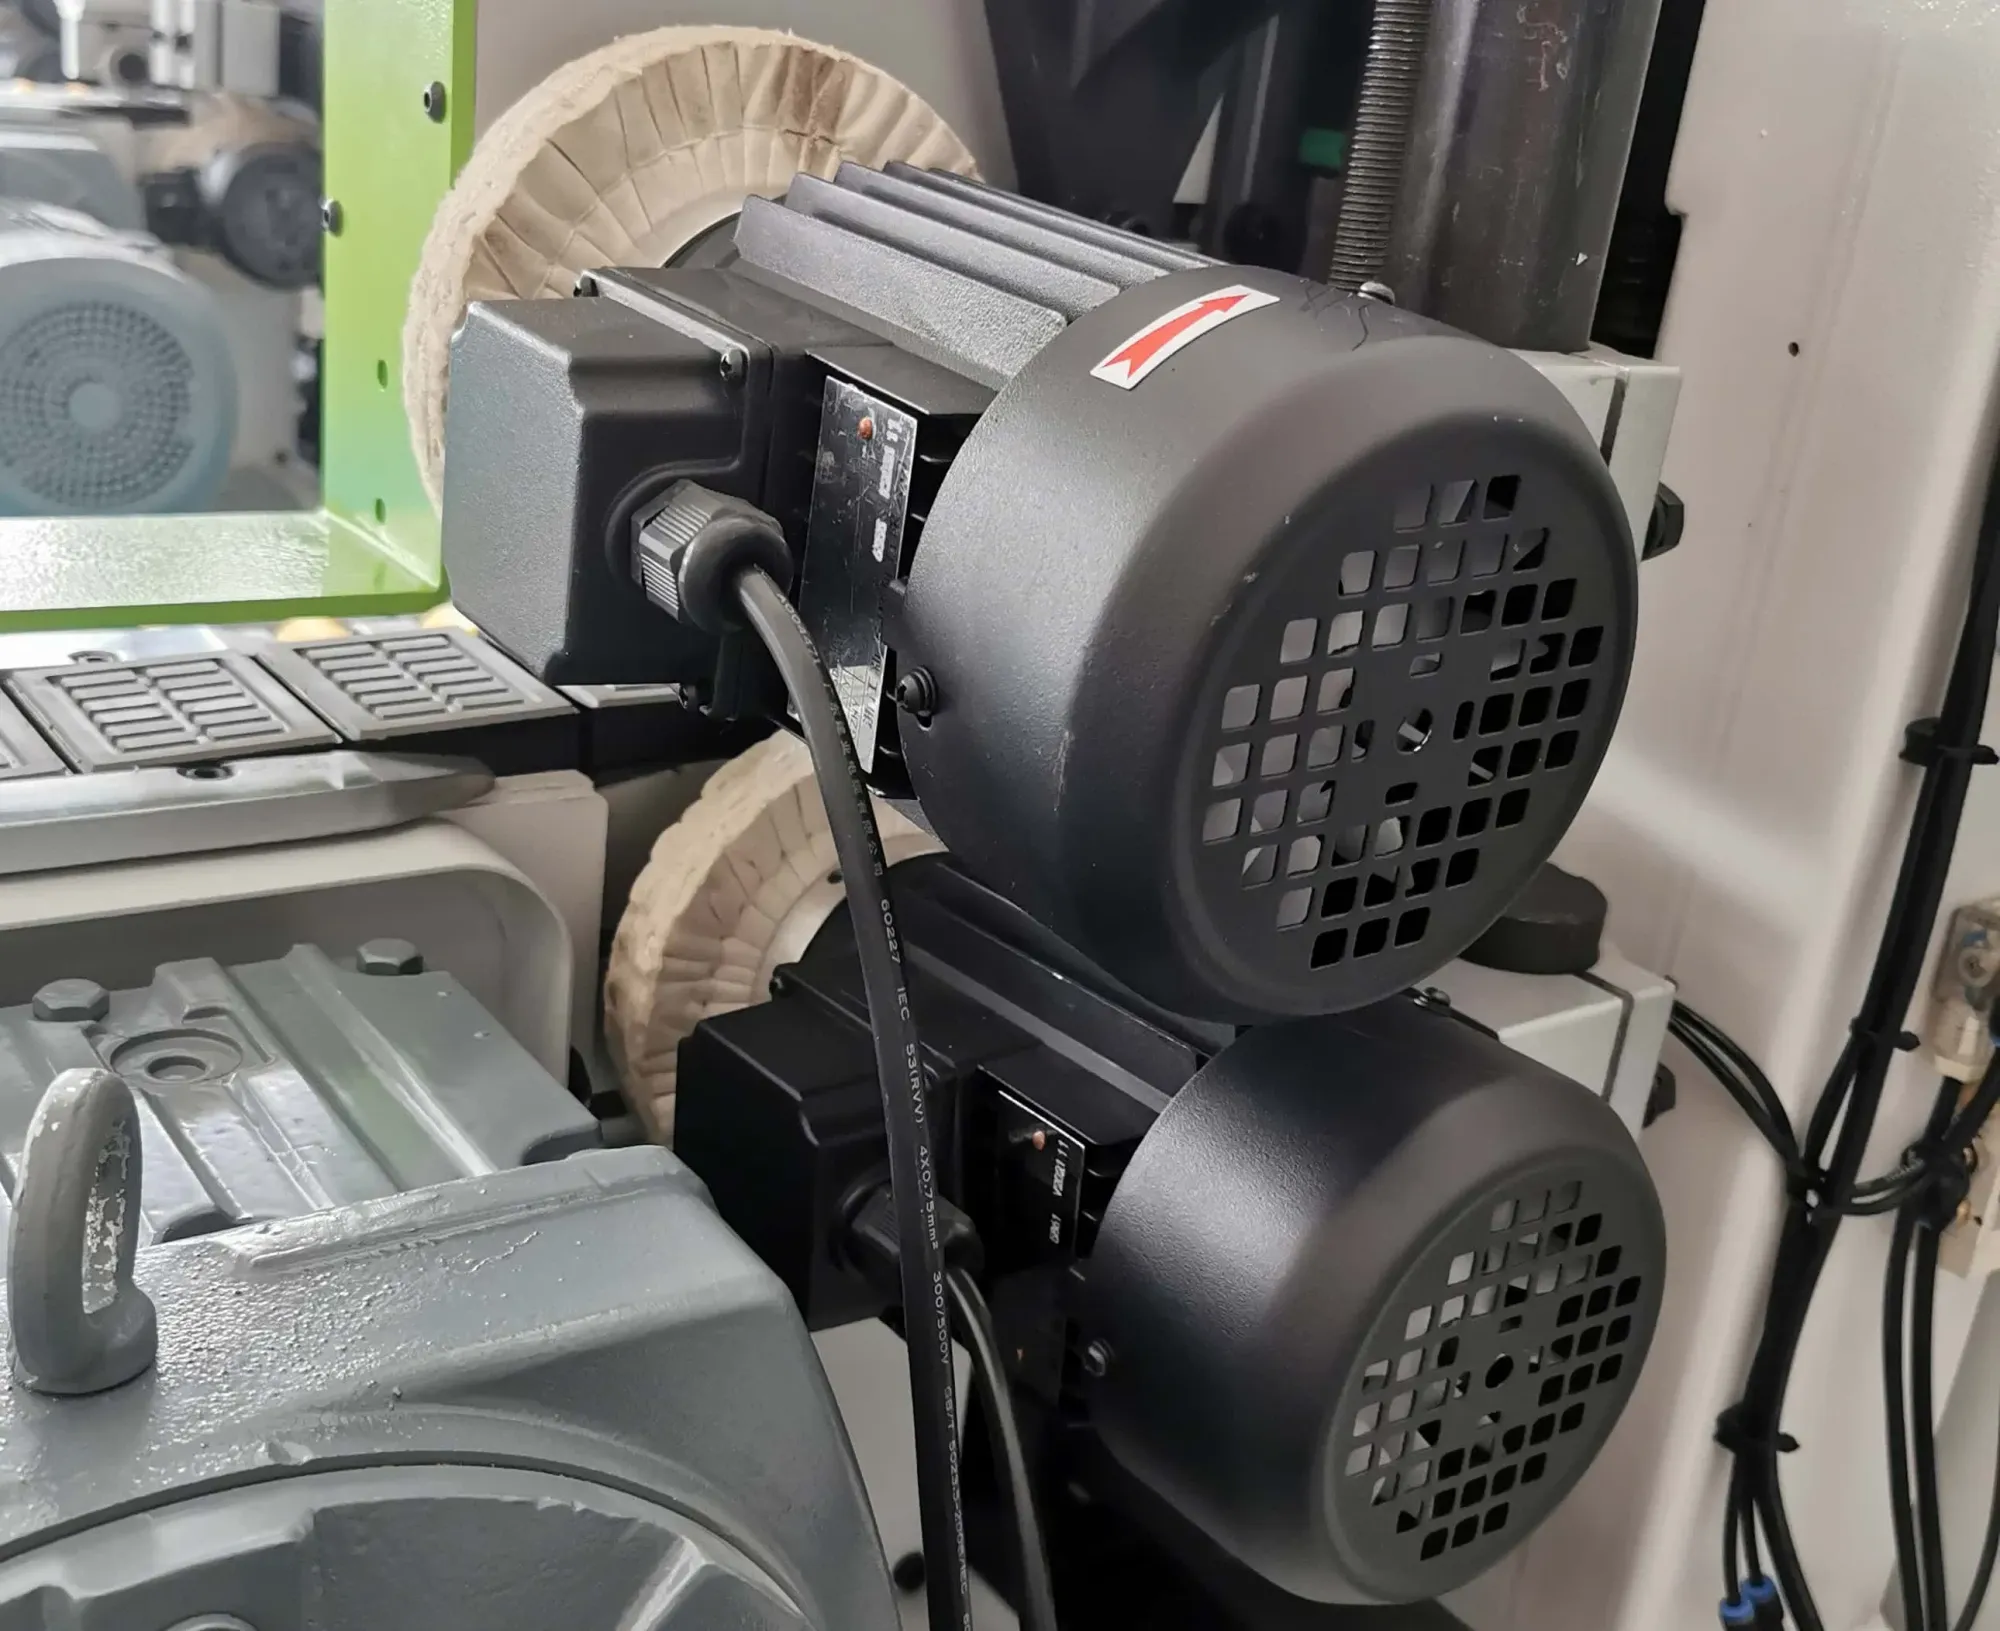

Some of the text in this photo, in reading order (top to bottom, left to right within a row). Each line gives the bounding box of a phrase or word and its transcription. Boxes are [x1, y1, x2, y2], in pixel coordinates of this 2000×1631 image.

[880, 898, 901, 964] 60227
[897, 986, 910, 1021] IEC
[906, 1043, 925, 1124] 53(RVV)
[933, 1270, 950, 1364] 300/500V
